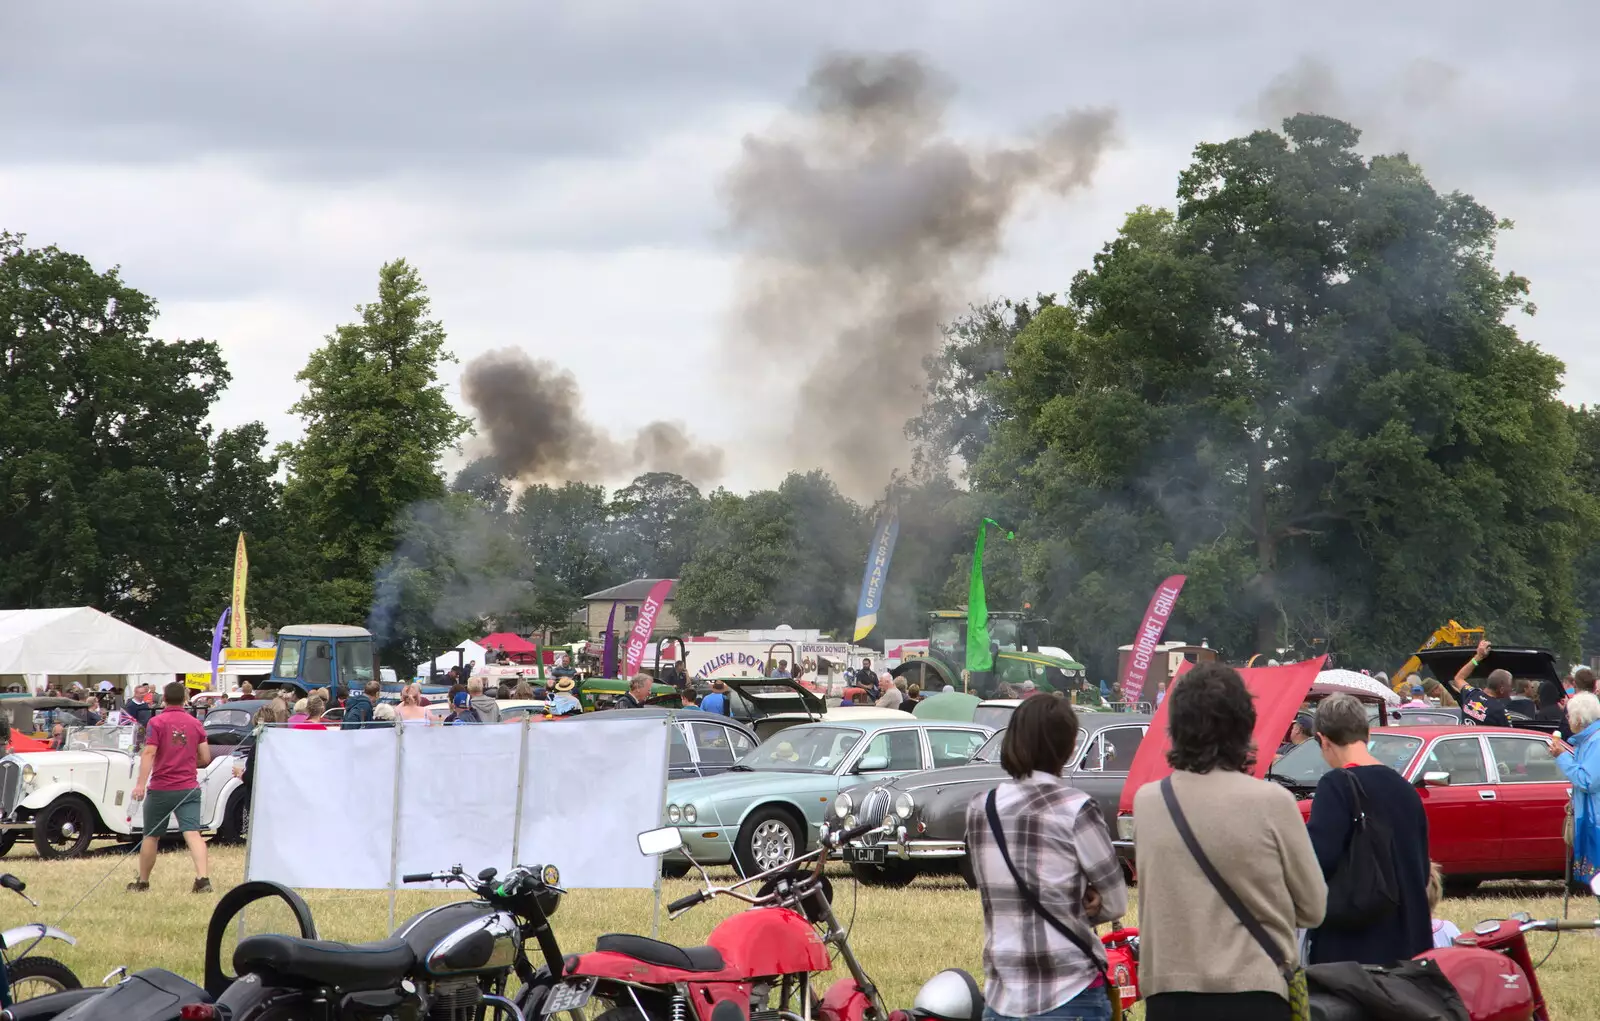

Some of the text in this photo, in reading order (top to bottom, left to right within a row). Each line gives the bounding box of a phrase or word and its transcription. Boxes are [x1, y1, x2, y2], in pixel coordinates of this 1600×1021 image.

[626, 595, 659, 666] HOG ROAST
[1133, 587, 1178, 670] GOURMET GRILL
[802, 645, 824, 653] DEVILISH
[695, 652, 765, 680] EVILISH DO'N
[858, 849, 875, 861] CJW
